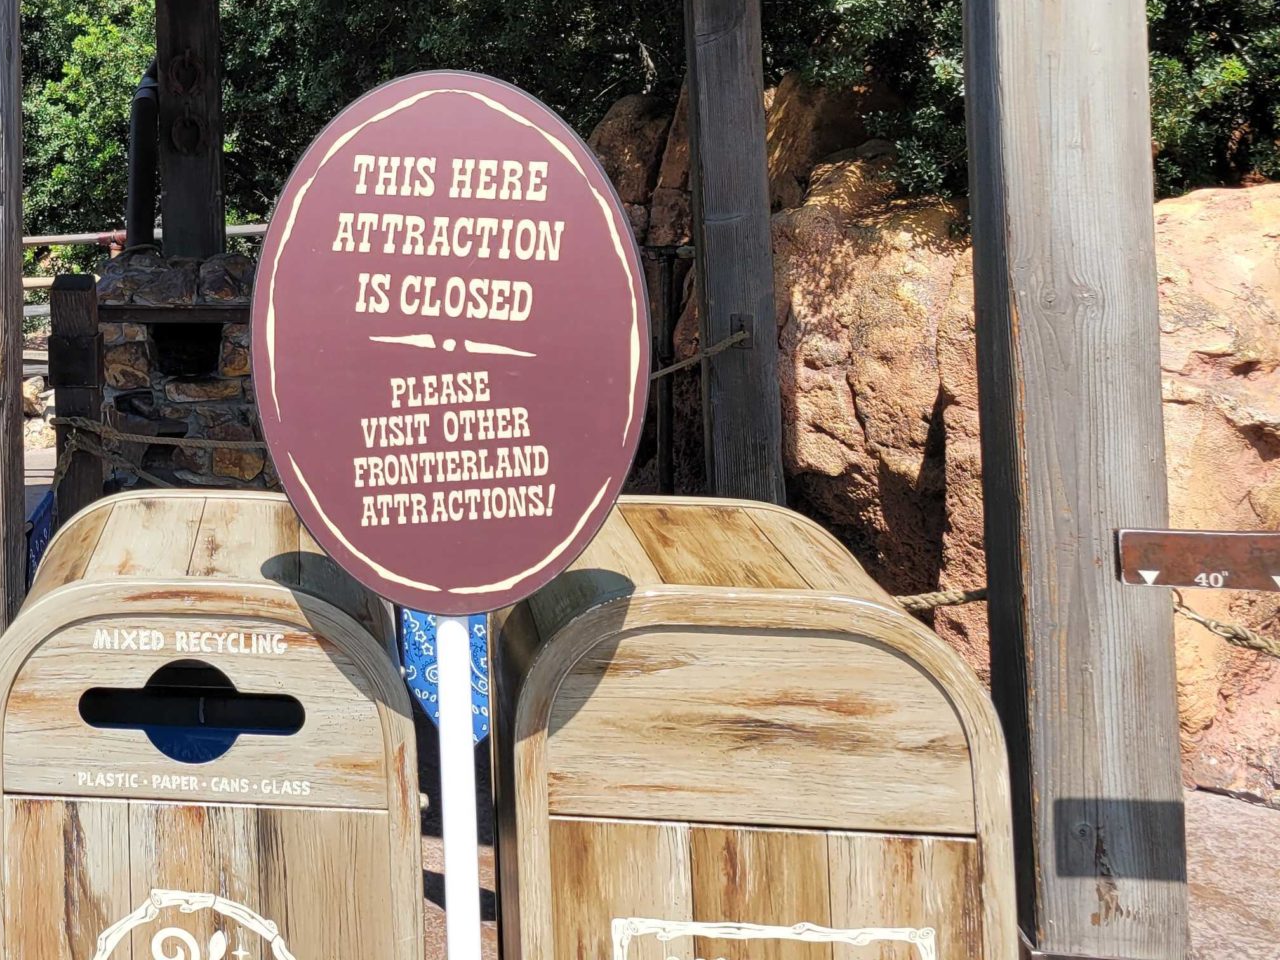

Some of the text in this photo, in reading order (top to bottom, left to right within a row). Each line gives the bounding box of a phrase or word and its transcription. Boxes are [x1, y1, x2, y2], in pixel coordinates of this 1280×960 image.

[353, 155, 548, 201] THIS HERE
[332, 213, 565, 261] ATTRACTION
[355, 273, 533, 322] IS CLOSED
[390, 371, 490, 408] PLEASE
[361, 407, 530, 448] VISIT OTHER
[354, 445, 549, 488] FRONTIERLAND
[361, 484, 556, 526] ATTRACTIONS!
[1194, 570, 1229, 587] 40"
[92, 629, 287, 655] MIXED RECYCLING
[77, 772, 311, 795] PLASTIC PAPER CANS GLASS
